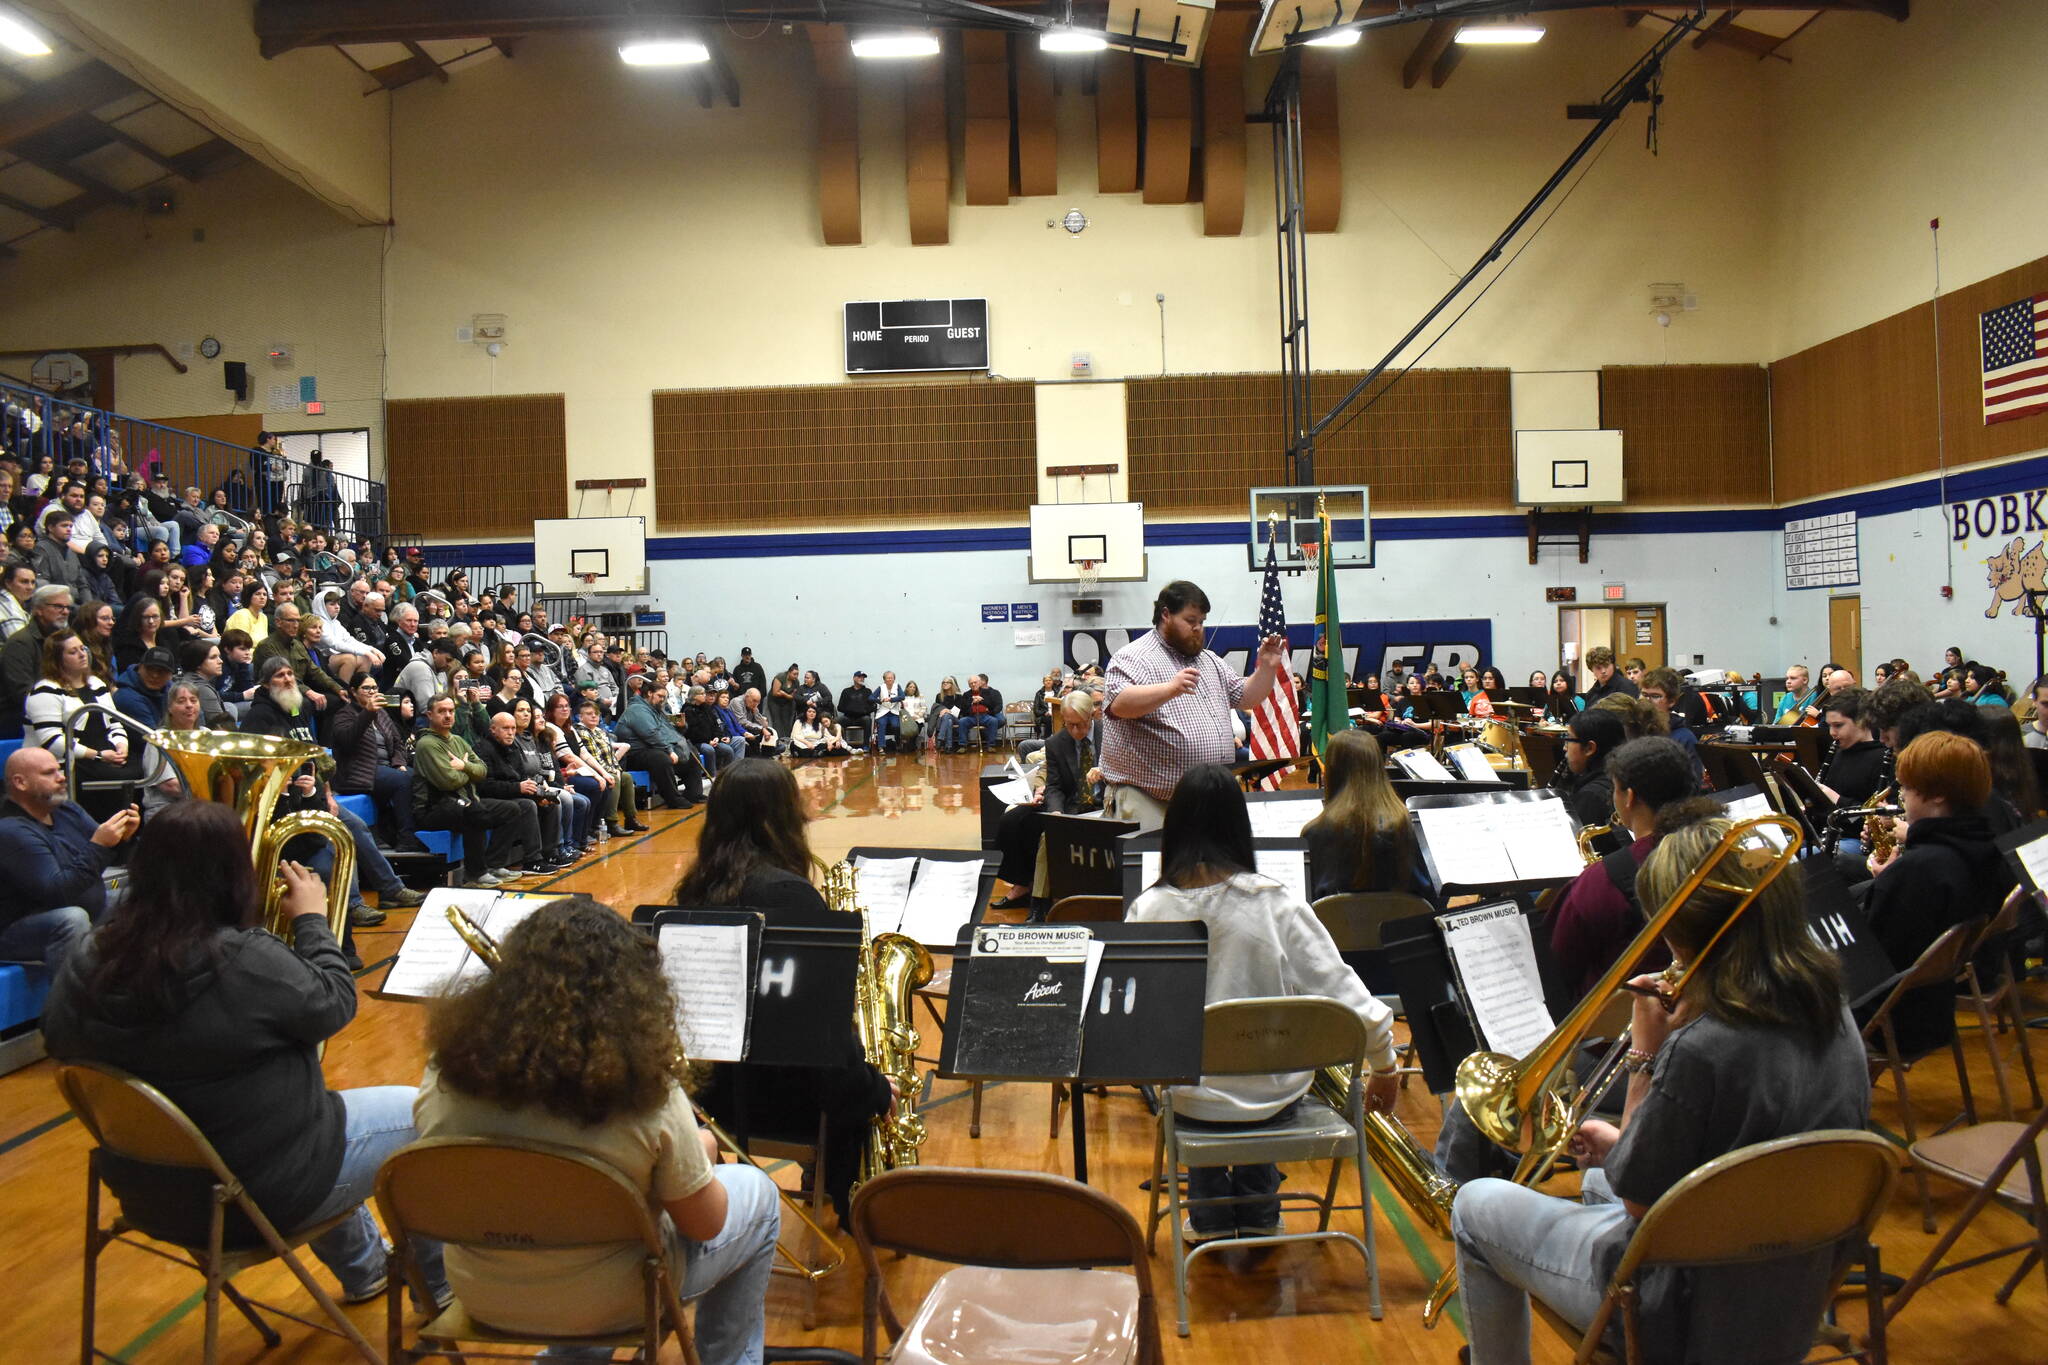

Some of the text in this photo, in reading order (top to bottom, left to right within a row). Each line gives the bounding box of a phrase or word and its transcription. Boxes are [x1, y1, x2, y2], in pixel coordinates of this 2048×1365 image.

[852, 330, 883, 342] HOME
[904, 335, 930, 343] PERIOD
[947, 327, 981, 340] GUEST
[1137, 503, 1142, 511] 3
[1952, 489, 2048, 541] BOBK
[1456, 906, 1517, 927] TED BROWN MUSIC
[997, 931, 1086, 941] TED BROWN MUSIC
[760, 957, 795, 997] H
[1024, 981, 1063, 1002] Accent
